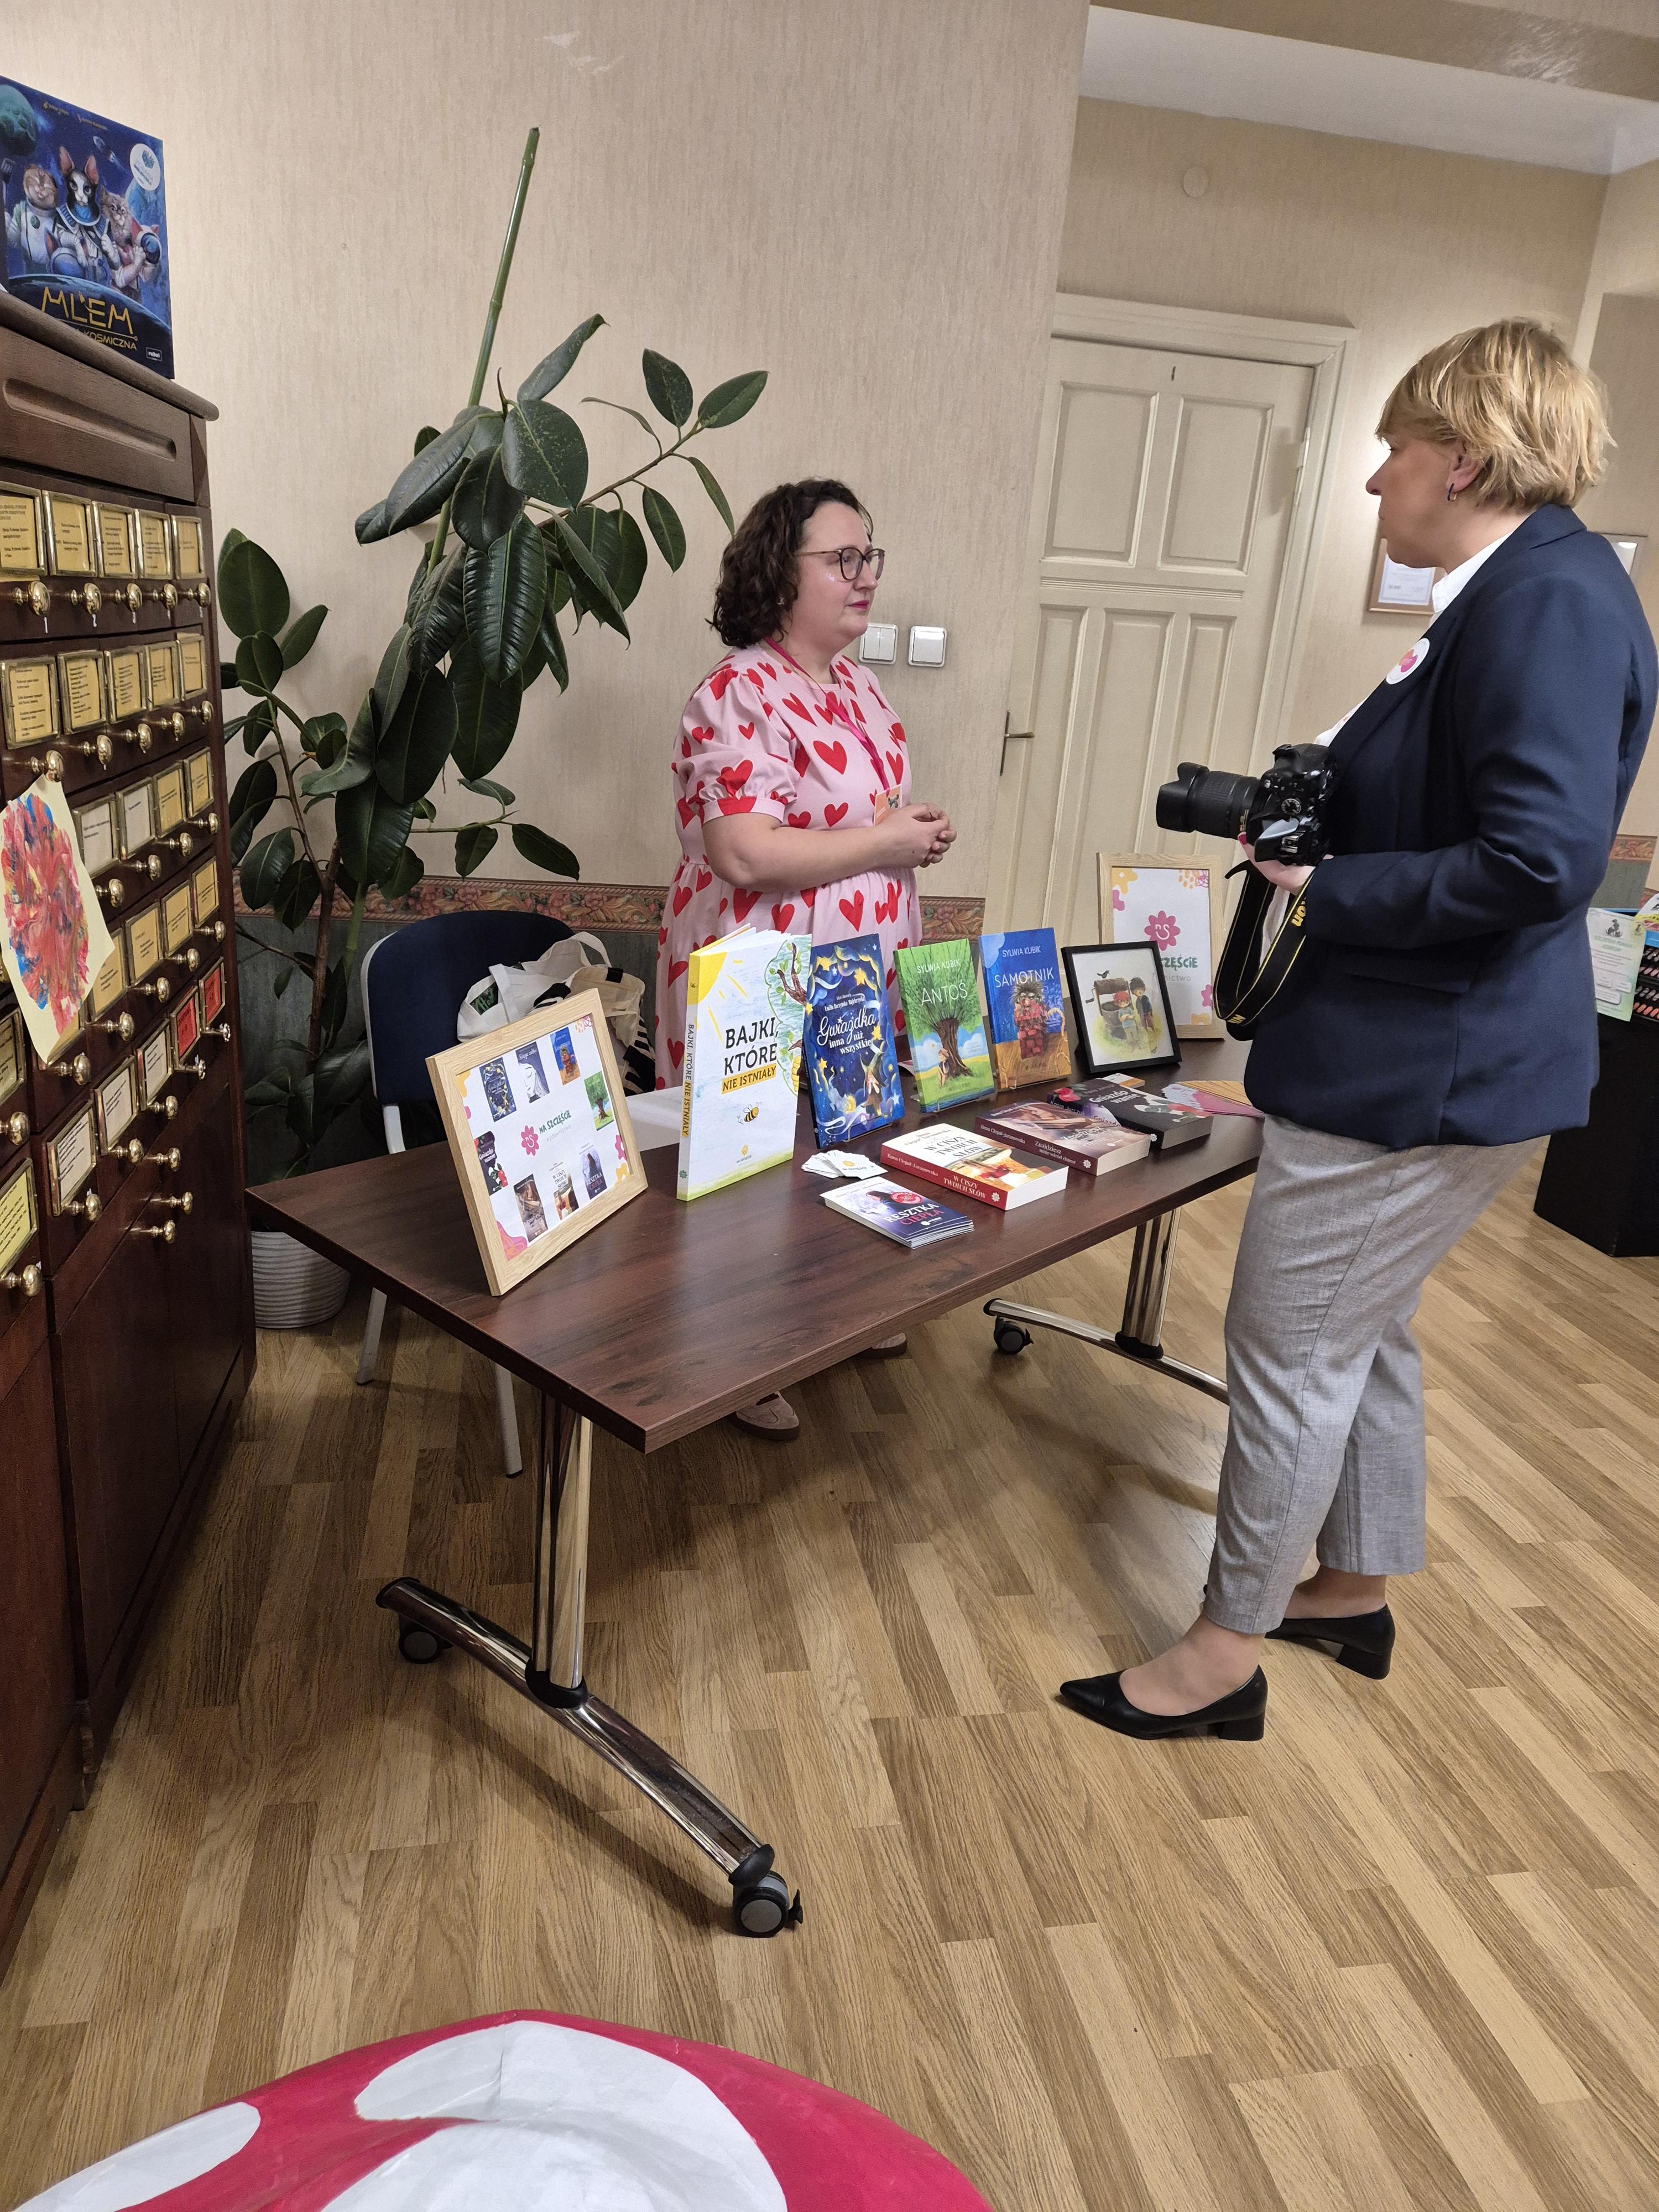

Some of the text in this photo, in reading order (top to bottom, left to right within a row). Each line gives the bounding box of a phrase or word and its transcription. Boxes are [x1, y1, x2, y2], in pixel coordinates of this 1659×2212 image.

[1003, 946, 1041, 957] SYLWIA KUBIK
[917, 958, 961, 974] SYLWIA KUBIK
[994, 967, 1055, 988] SAMOTNIK
[919, 979, 968, 1006] ANTOŚ
[726, 1016, 779, 1049] BAJKI,
[817, 1005, 877, 1046] Gwiazdka
[829, 1030, 864, 1048] inna niż
[840, 1039, 872, 1054] wszystkie
[724, 1043, 778, 1076] KTÓRE
[722, 1066, 776, 1092] NIE ISTNIAŁY
[1088, 1090, 1129, 1103] Gniazdo
[1109, 1093, 1141, 1104] wanie
[682, 1097, 690, 1136] ISTNIAŁY
[539, 1124, 547, 1134] NA
[1035, 1140, 1062, 1155] Znajdziesz
[943, 1178, 987, 1199] TWOICH SŁÓW
[961, 1177, 979, 1190] CISZY
[883, 1203, 940, 1223] RESZTKA
[899, 1209, 945, 1225] CIEPŁA
